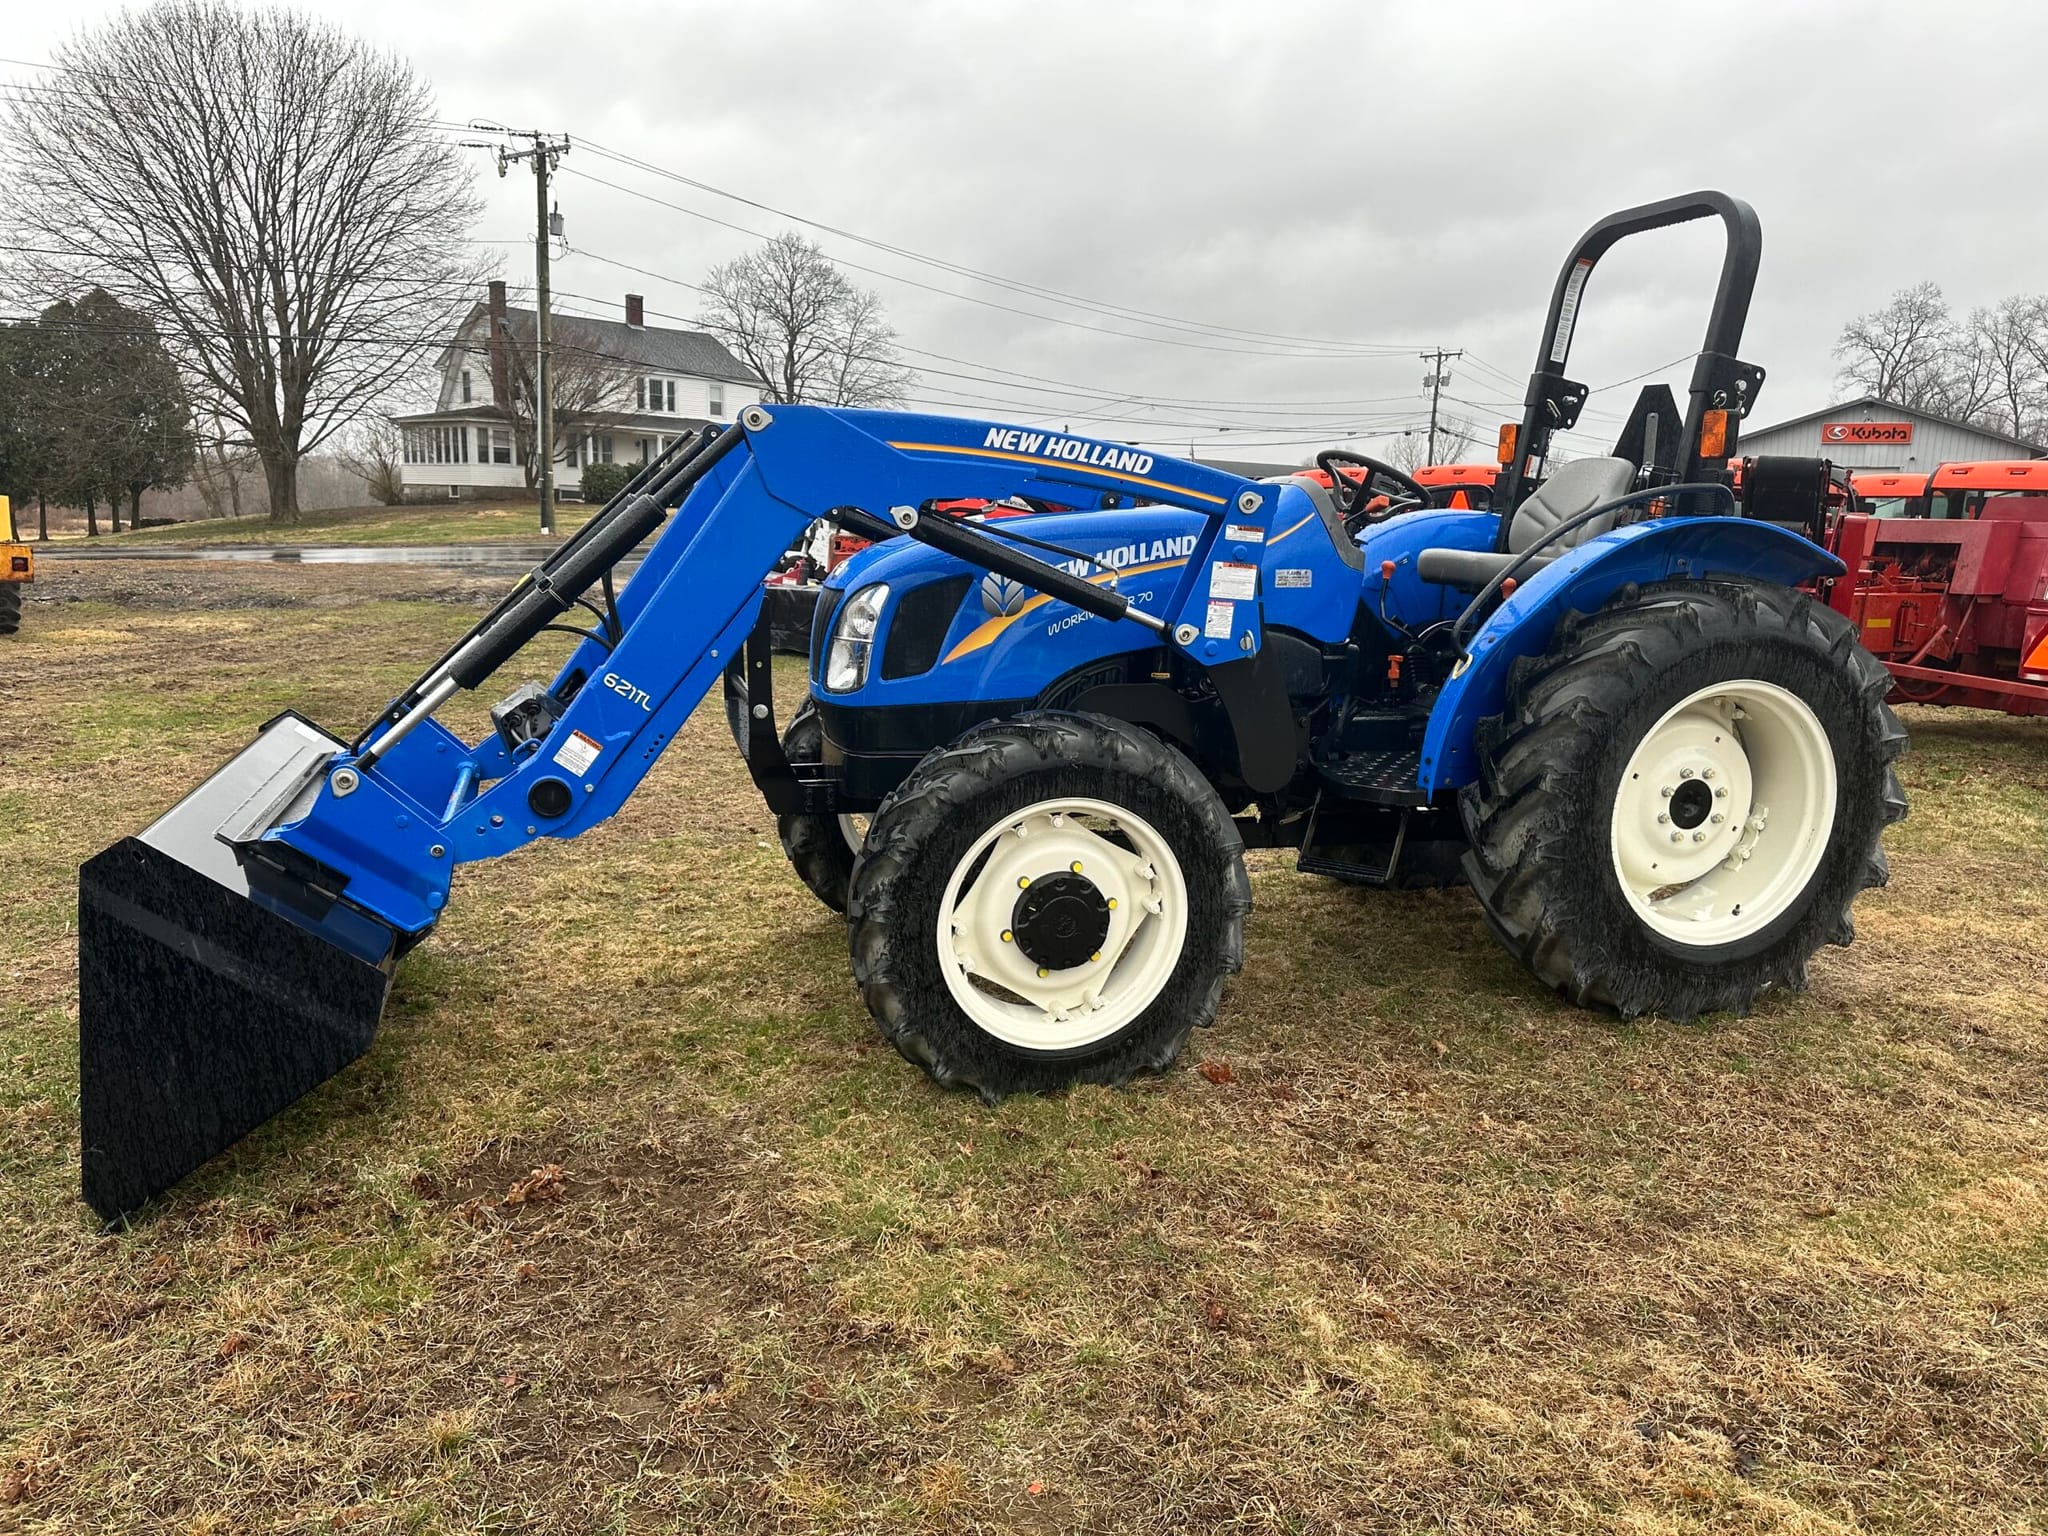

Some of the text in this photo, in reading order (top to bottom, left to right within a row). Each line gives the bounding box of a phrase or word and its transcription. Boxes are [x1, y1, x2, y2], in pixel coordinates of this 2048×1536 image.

[983, 427, 1154, 475] NEW HOLLAND
[1851, 427, 1907, 439] Kubota
[1095, 535, 1198, 573] HOLLAND
[1137, 591, 1154, 604] 70
[603, 672, 651, 712] 621TL
